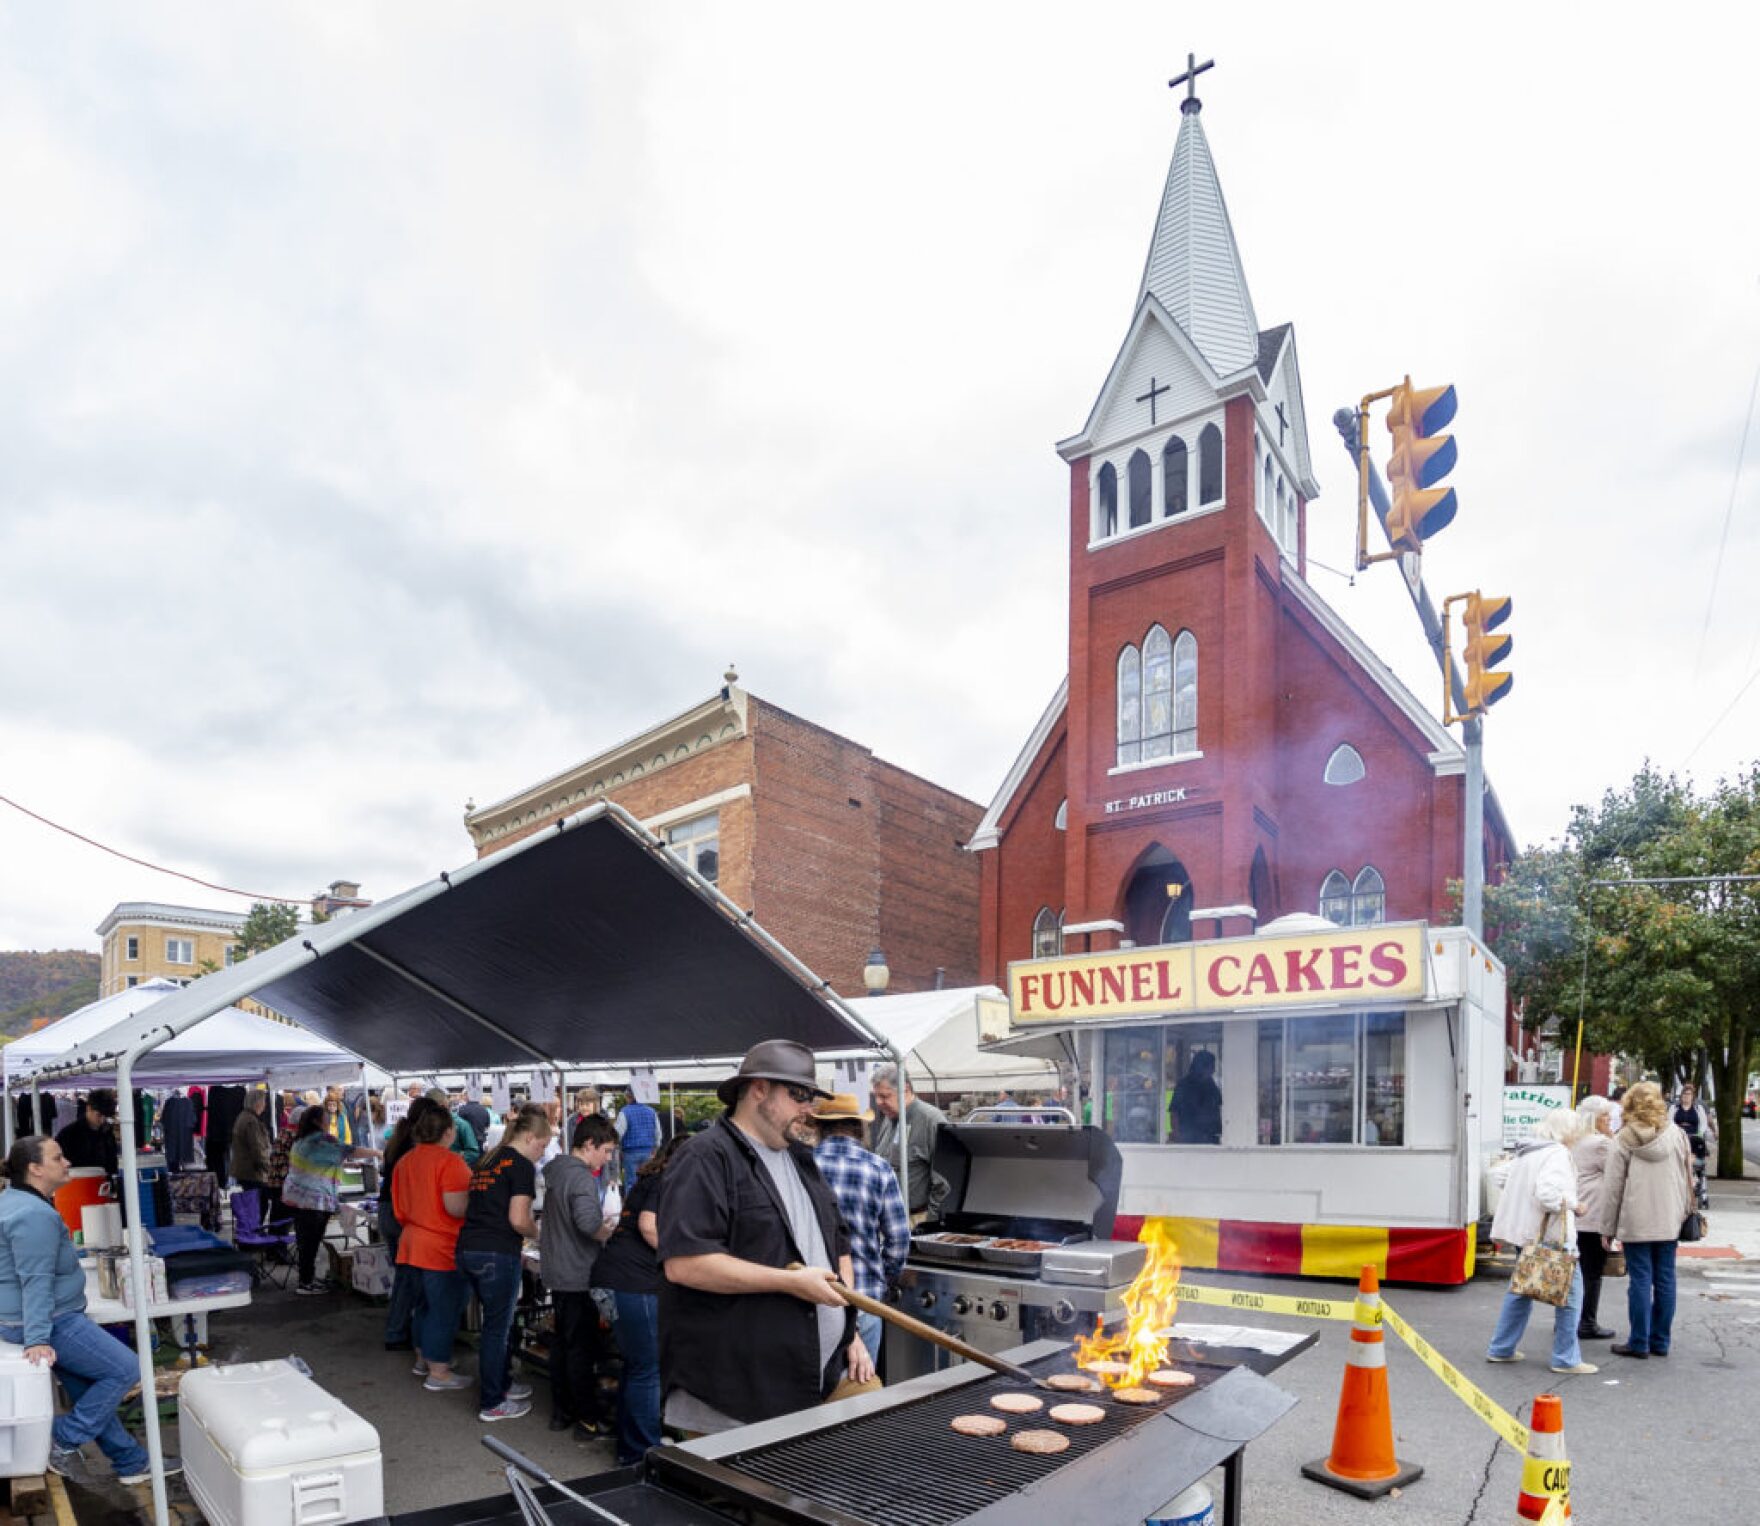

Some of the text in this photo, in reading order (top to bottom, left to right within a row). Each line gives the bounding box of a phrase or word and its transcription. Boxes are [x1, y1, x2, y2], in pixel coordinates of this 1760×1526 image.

[1129, 787, 1187, 810] PATRICK
[1020, 941, 1407, 1012] FUNNEL CAKES
[1504, 1090, 1562, 1109] atric
